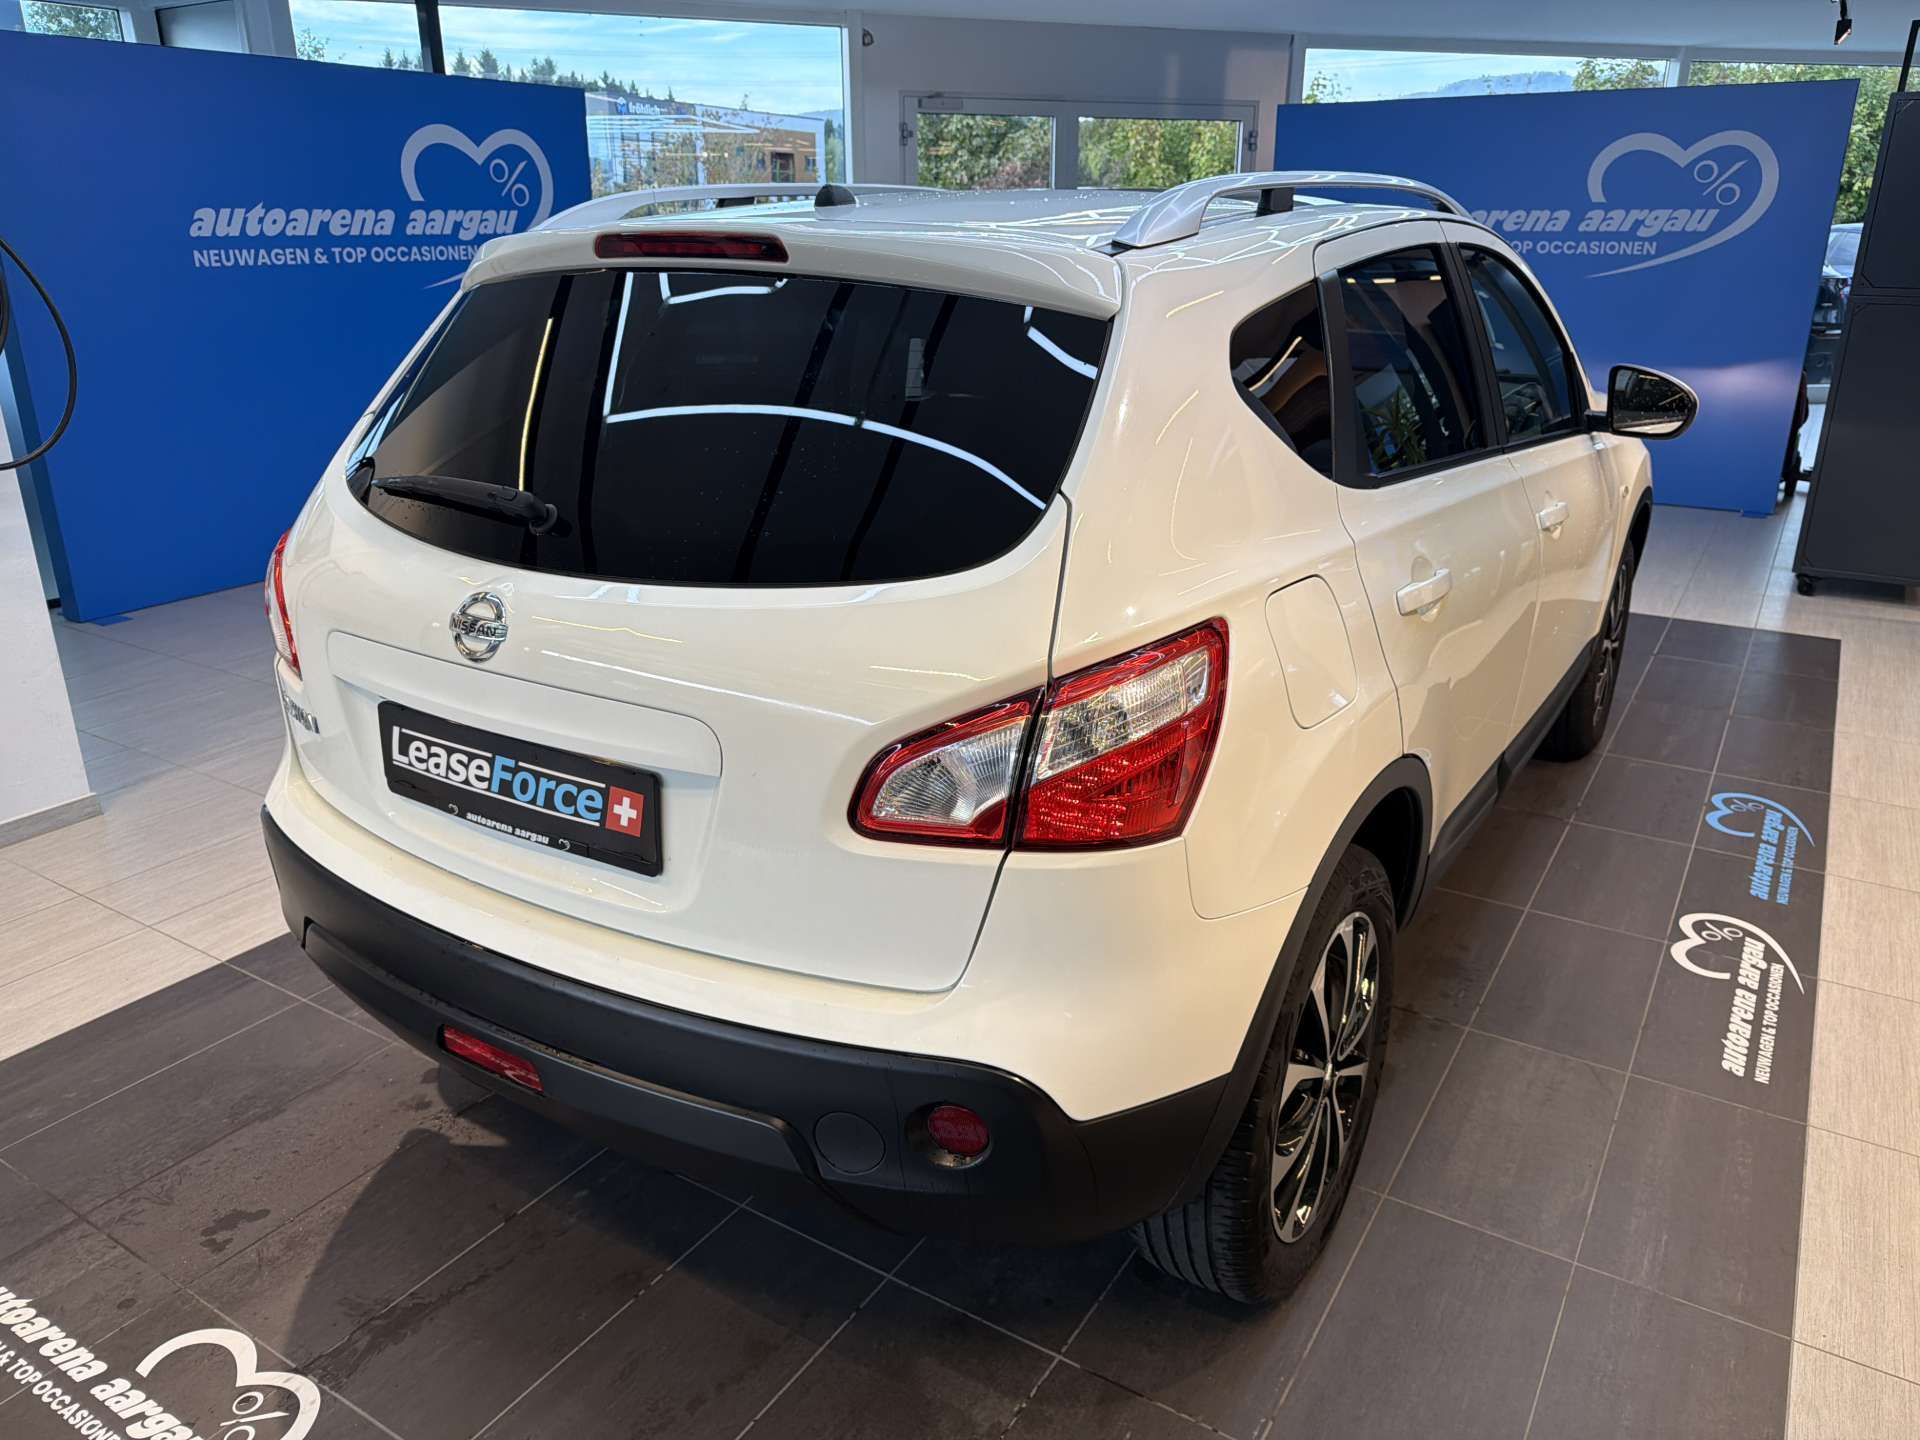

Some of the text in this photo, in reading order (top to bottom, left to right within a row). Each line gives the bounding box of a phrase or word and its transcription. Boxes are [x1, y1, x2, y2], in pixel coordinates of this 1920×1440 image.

[189, 200, 518, 241] autoarena aargau
[1578, 208, 1719, 237] aargau
[193, 244, 479, 268] NEUWAGEN & TOP OCCASIONEN
[1507, 240, 1657, 255] OP OCCASIONEN
[451, 615, 497, 638] NISSAN
[391, 725, 603, 822] LeaseForce
[465, 812, 550, 844] autoarena aargau
[1749, 808, 1785, 900] autoarena aargau
[1721, 936, 1767, 1077] autoarena aargau
[1754, 962, 1785, 1085] NEUWAGEN & TOP OCCASIONEN
[6, 1358, 42, 1384] TOP
[90, 1377, 206, 1440] aarga
